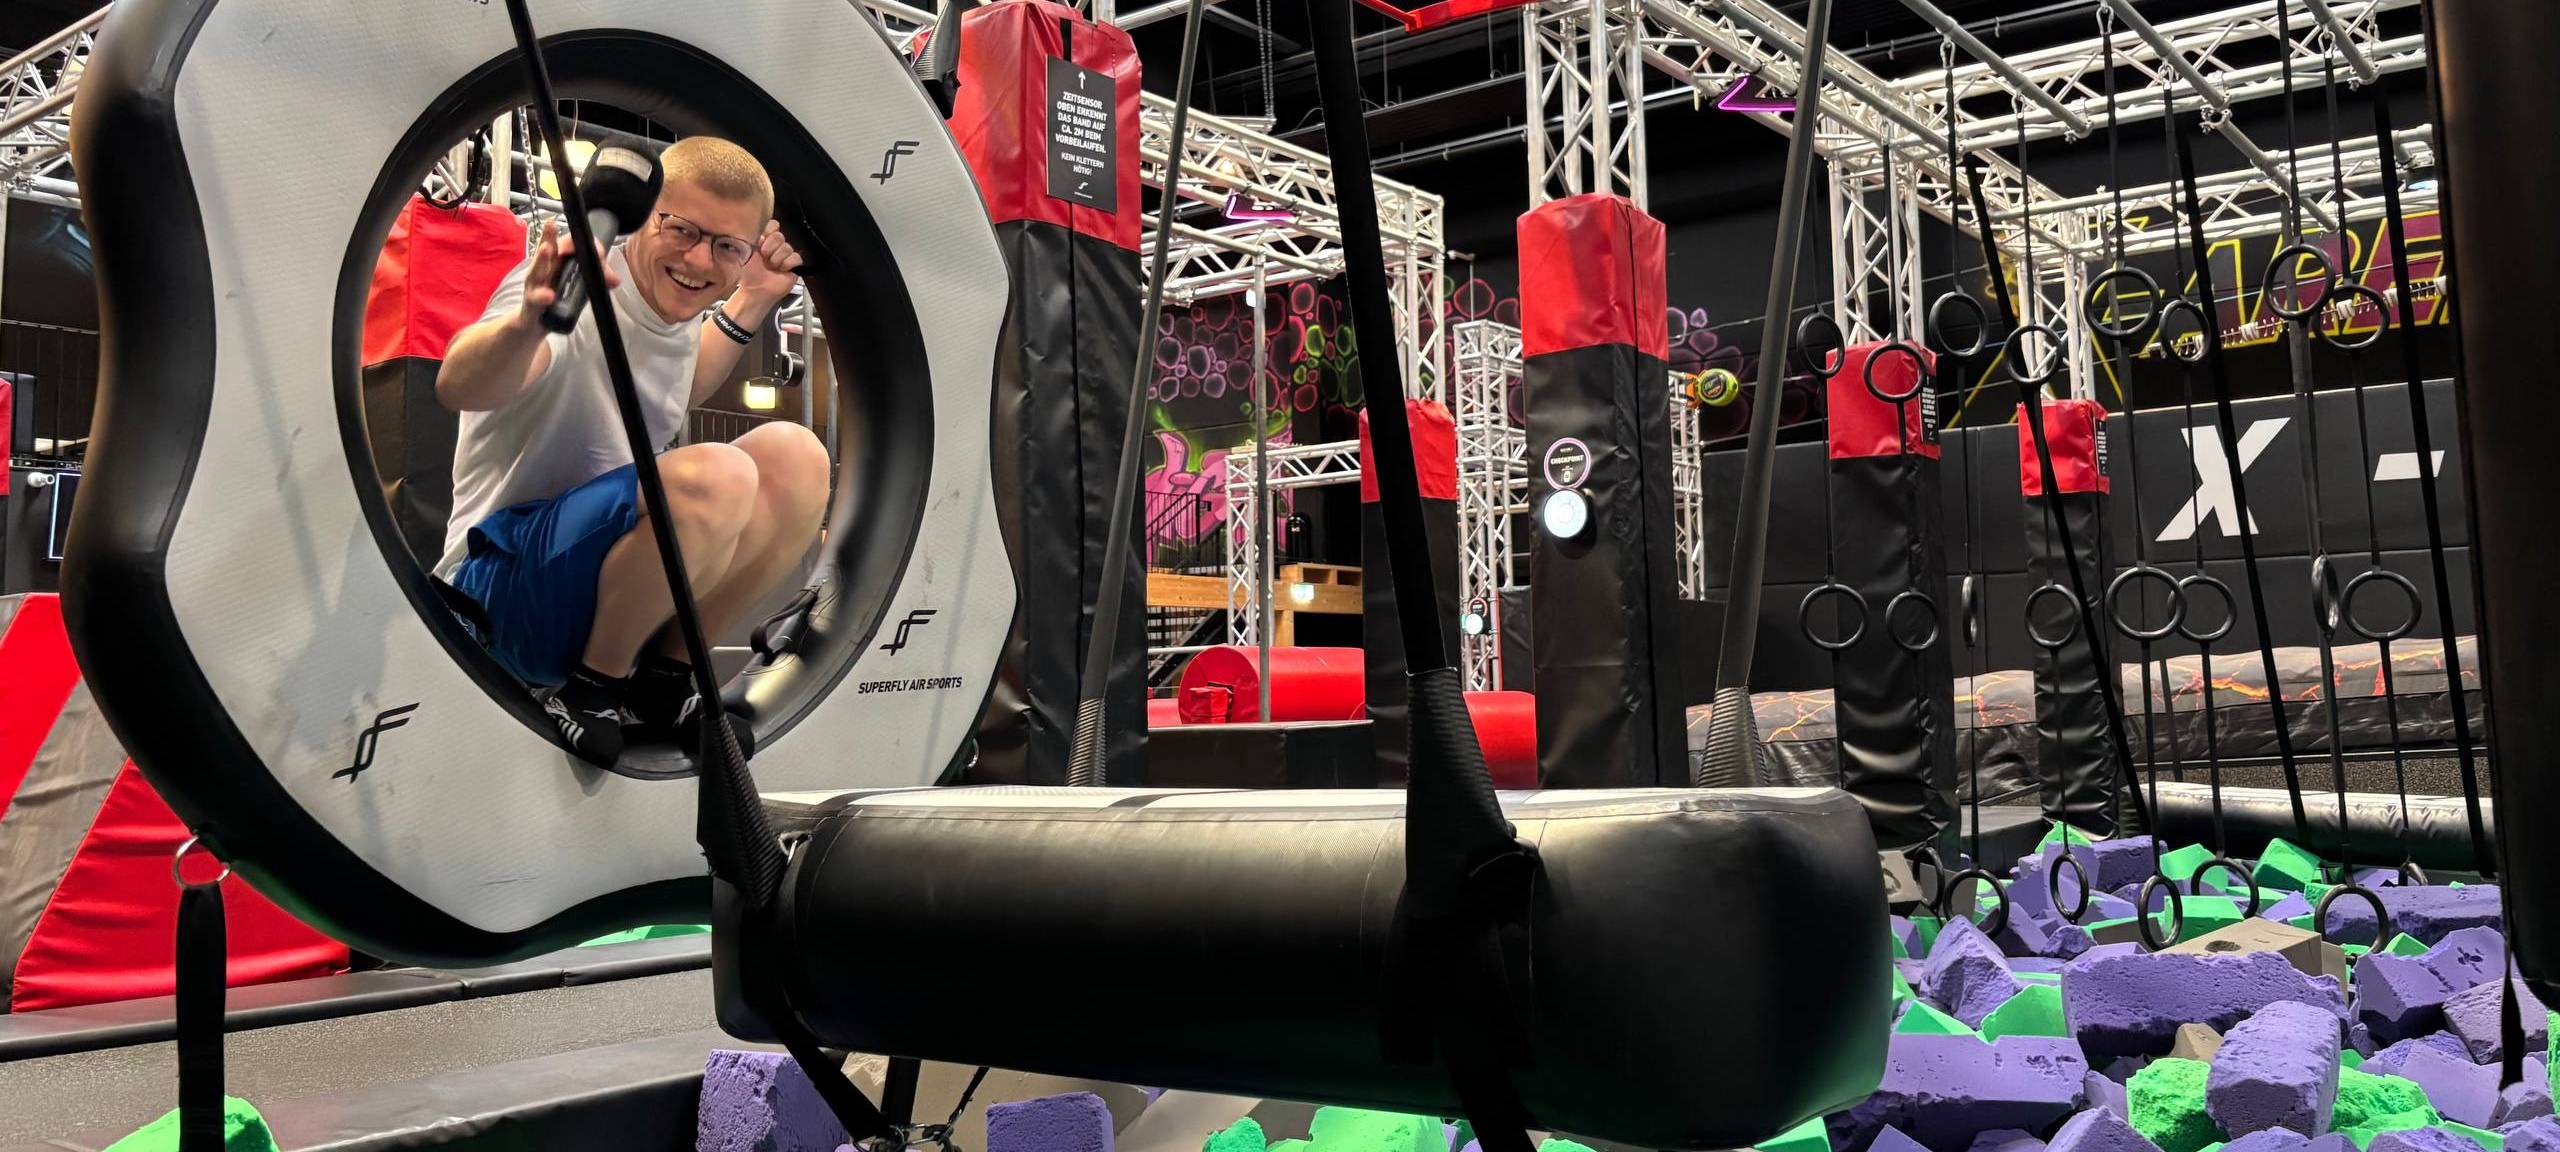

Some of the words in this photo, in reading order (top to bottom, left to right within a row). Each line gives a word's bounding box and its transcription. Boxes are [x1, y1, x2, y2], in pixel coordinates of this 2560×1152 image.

[1063, 91, 1103, 110] ZEITSENSOR
[1056, 101, 1076, 113] OBEN
[1076, 106, 1108, 121] ERKENNT
[1057, 112, 1072, 123] DAS
[1072, 116, 1092, 128] BAND
[1092, 121, 1106, 131] AUF
[1061, 124, 1073, 134] CA.
[1073, 127, 1084, 137] 2M
[1084, 129, 1102, 142] BEIM
[1055, 133, 1107, 154] VORBEILAUFEN.
[1061, 152, 1075, 162] KEIN
[1075, 155, 1105, 169] KLETTERN
[2155, 417, 2291, 542] X
[858, 680, 909, 694] SUPERFLY
[908, 678, 926, 691] AIR
[926, 676, 963, 690] SPORTS
